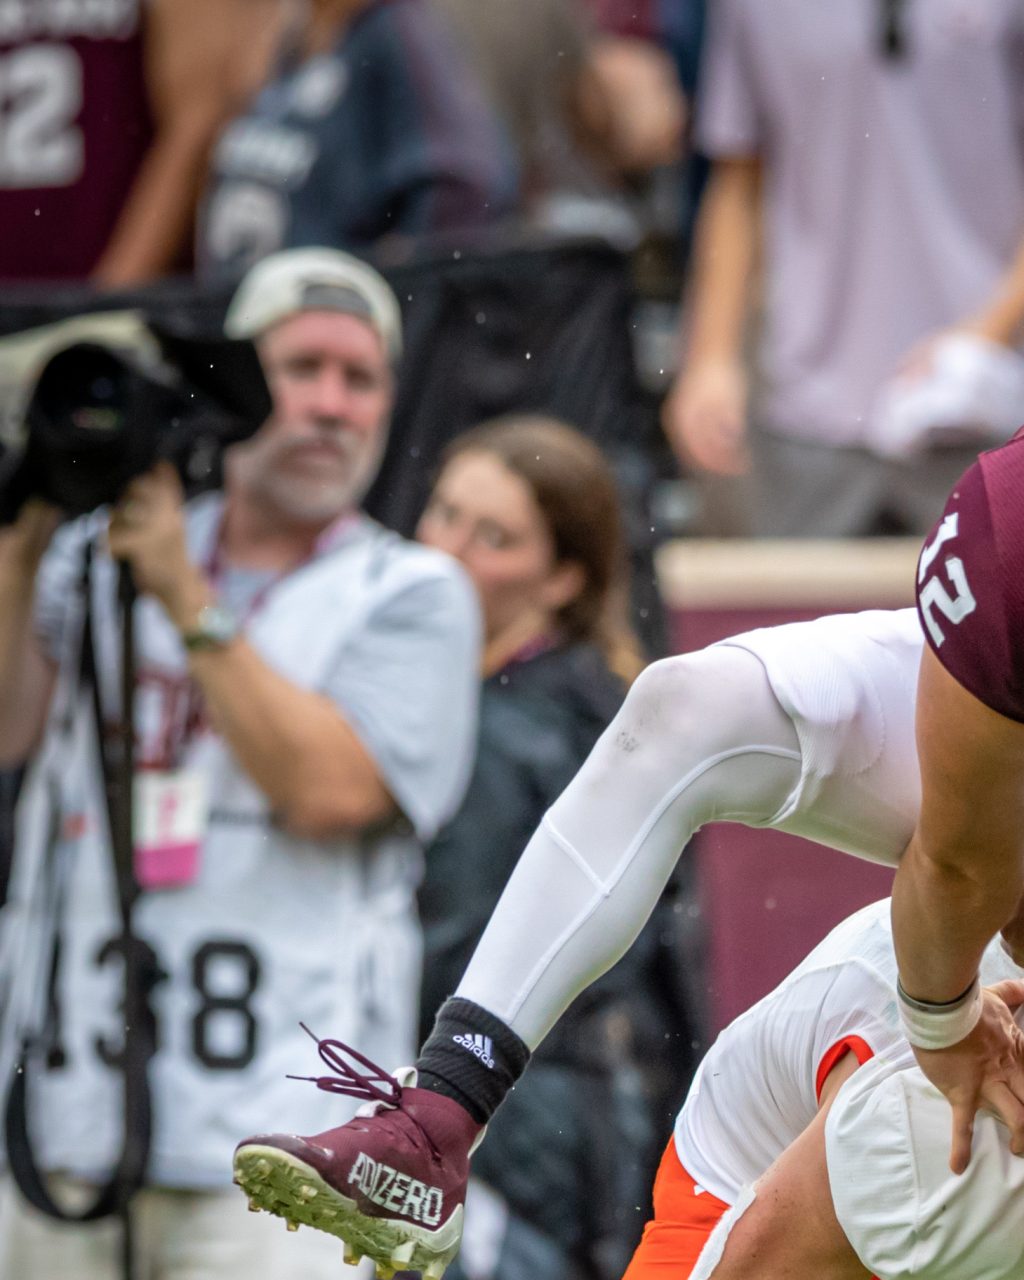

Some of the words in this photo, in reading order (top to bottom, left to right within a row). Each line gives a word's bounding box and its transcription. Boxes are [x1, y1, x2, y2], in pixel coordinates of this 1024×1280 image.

[918, 512, 977, 648] 12
[452, 1033, 495, 1070] adidas
[347, 1151, 444, 1226] ADIZERO
